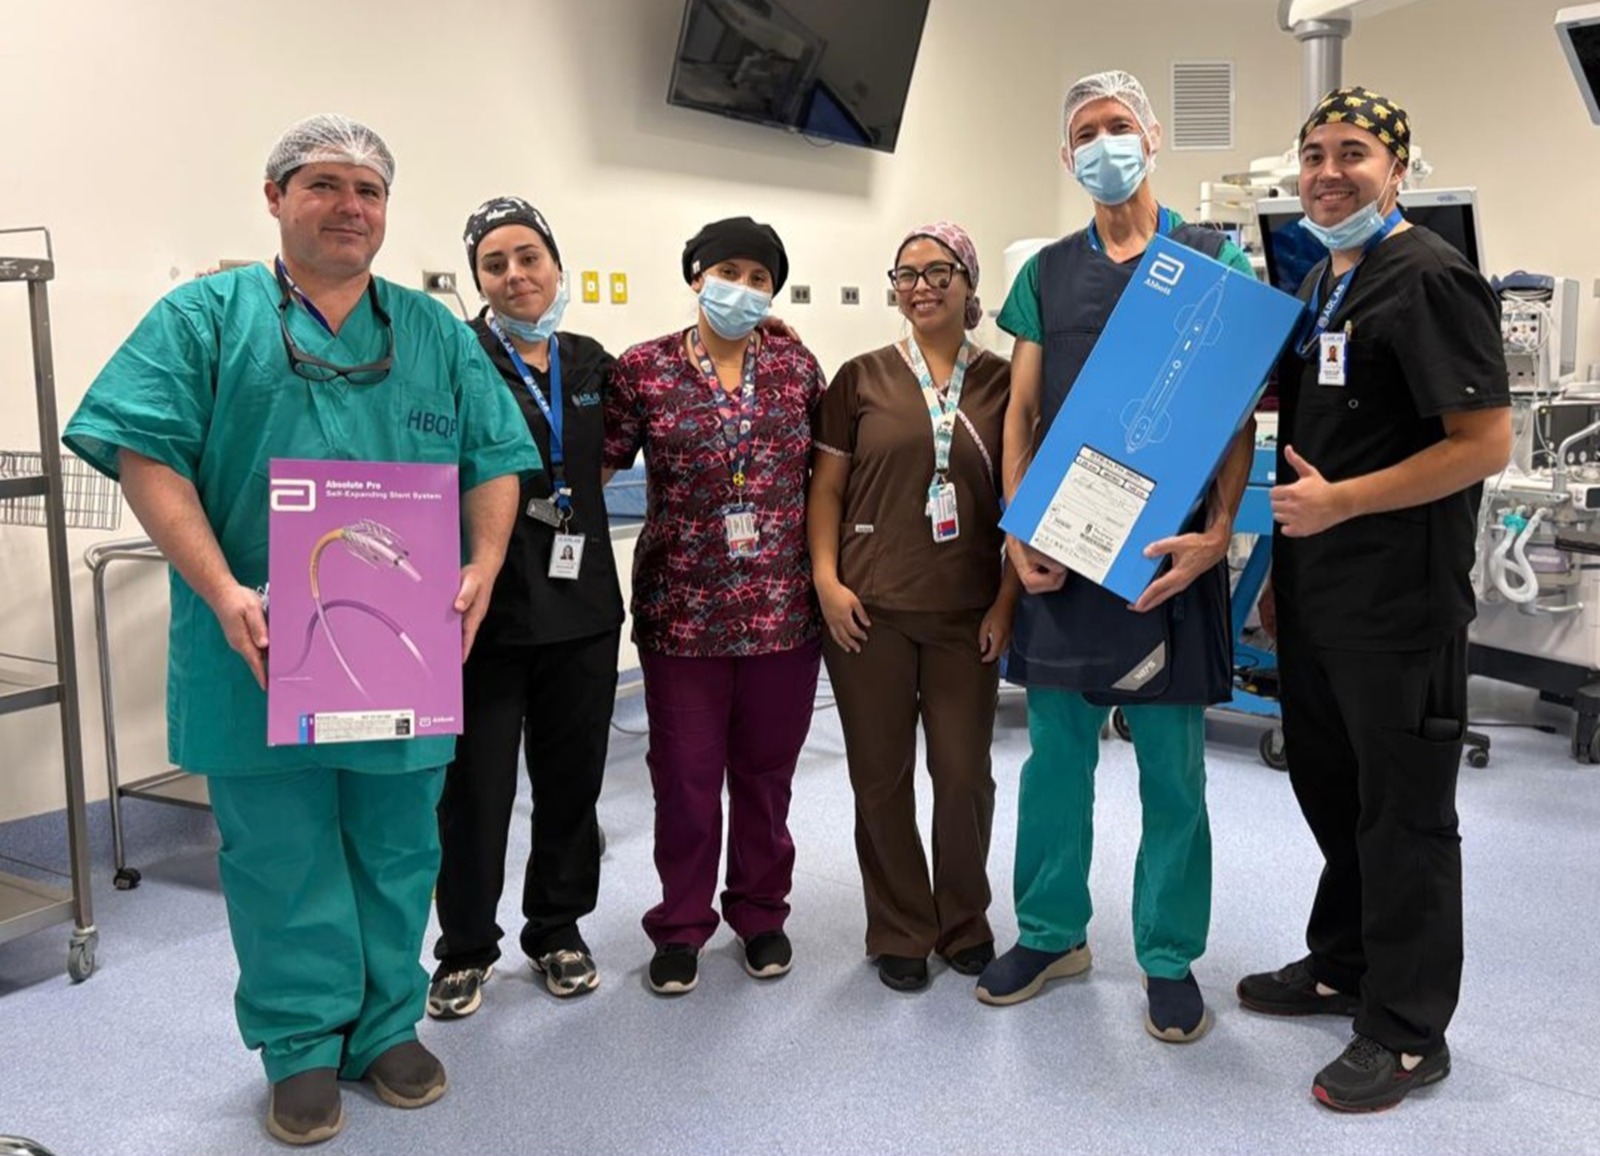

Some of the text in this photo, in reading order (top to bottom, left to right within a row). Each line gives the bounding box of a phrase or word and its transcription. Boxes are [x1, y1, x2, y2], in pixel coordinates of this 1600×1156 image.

[1143, 278, 1171, 296] Abbott
[325, 480, 381, 490] Absolute Pro
[325, 490, 442, 501] Self-Expanding Stent System
